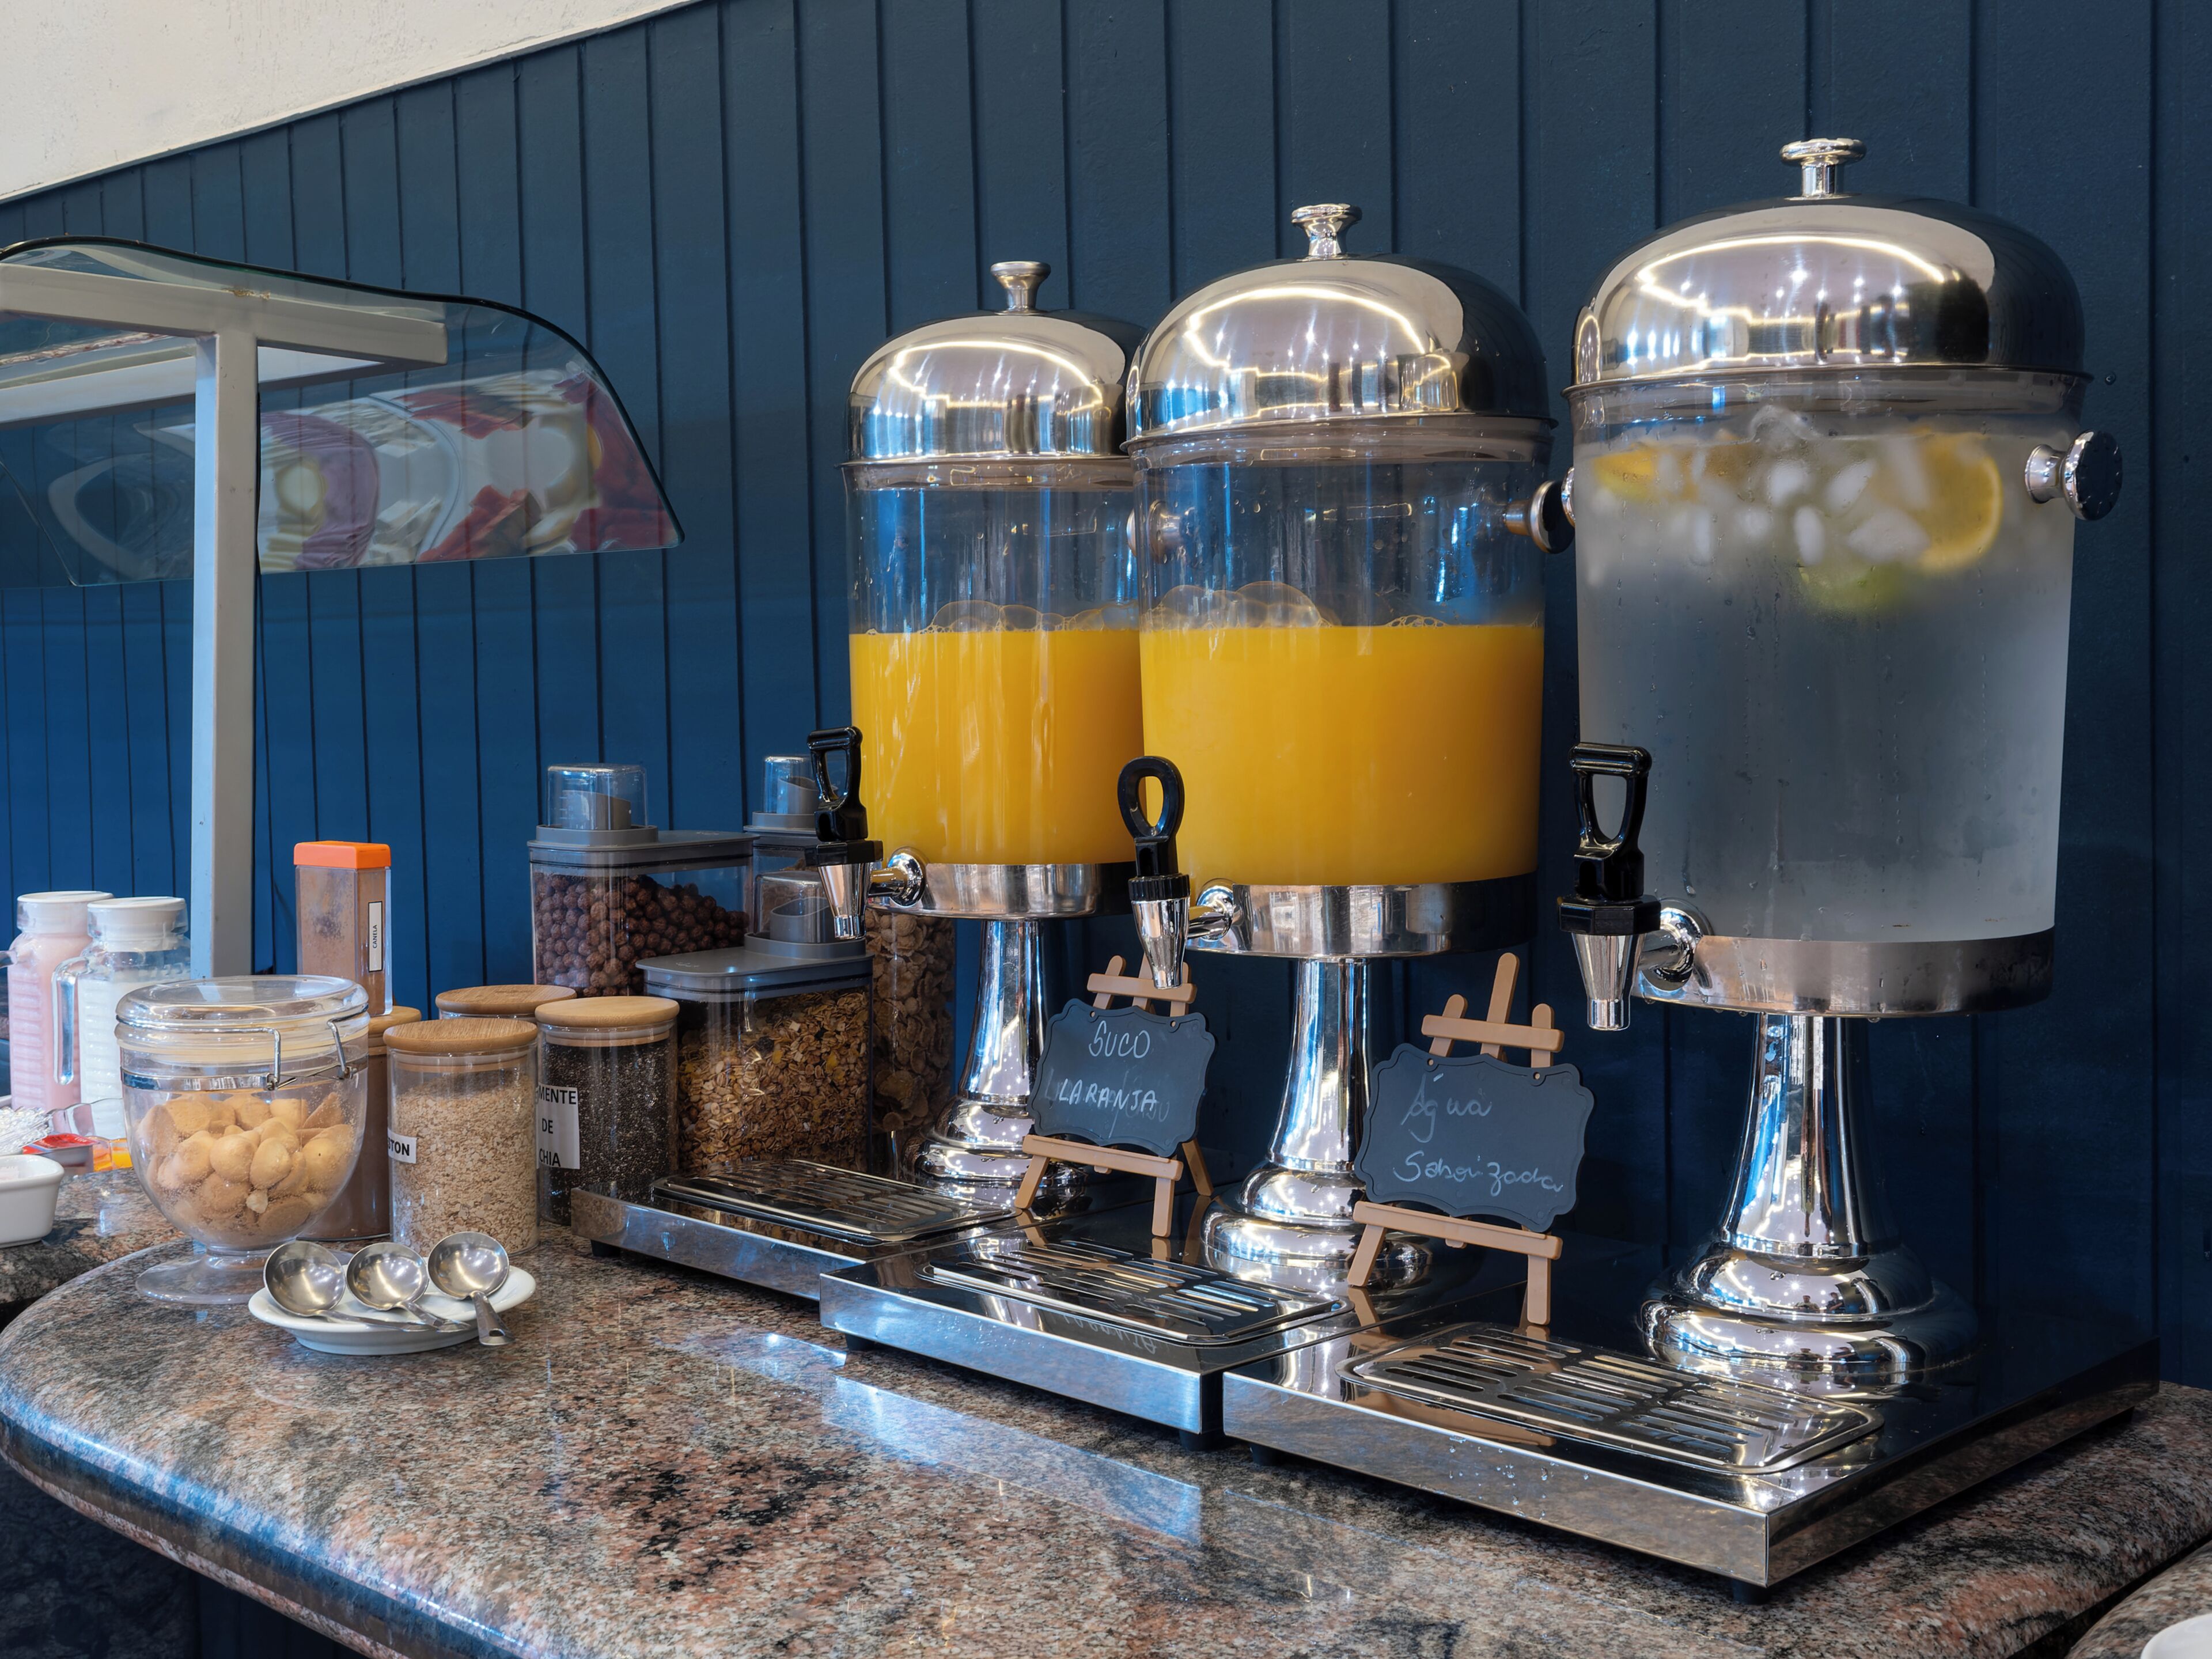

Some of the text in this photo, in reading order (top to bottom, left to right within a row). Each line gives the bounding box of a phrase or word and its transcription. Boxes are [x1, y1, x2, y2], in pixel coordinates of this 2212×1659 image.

[1089, 1020, 1151, 1058] SUCO
[1059, 1078, 1157, 1112] LARANJA
[542, 1118, 554, 1134] DE
[539, 1148, 561, 1167] CHIA
